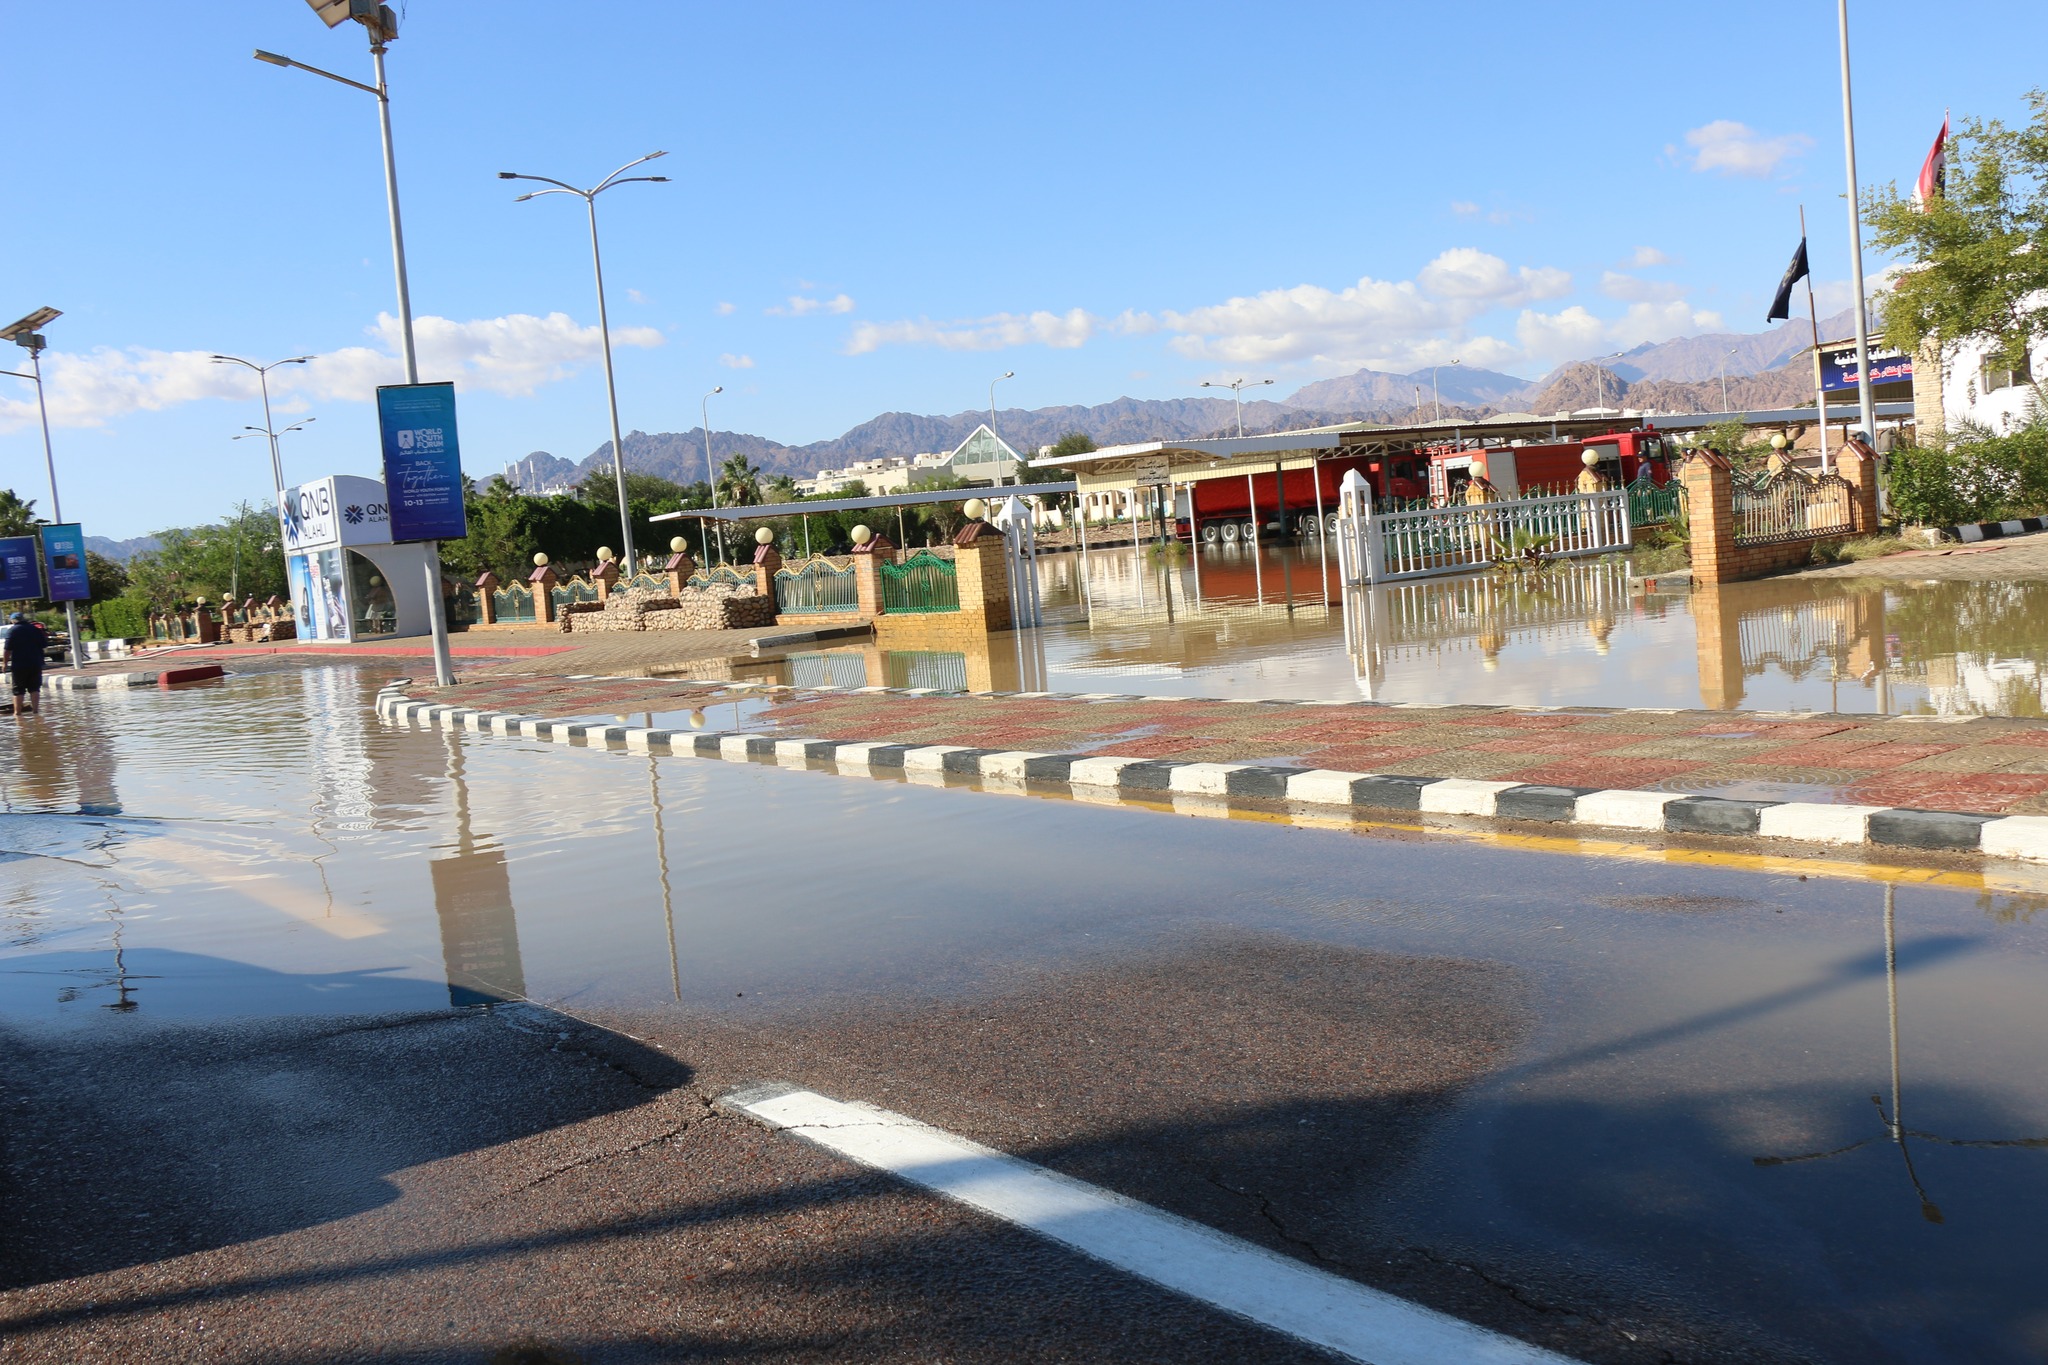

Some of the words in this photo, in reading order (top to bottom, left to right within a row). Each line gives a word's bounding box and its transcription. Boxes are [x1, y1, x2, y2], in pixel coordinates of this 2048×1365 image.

[300, 486, 330, 520] QNB
[366, 503, 388, 515] QN
[304, 522, 327, 541] ALAHLI
